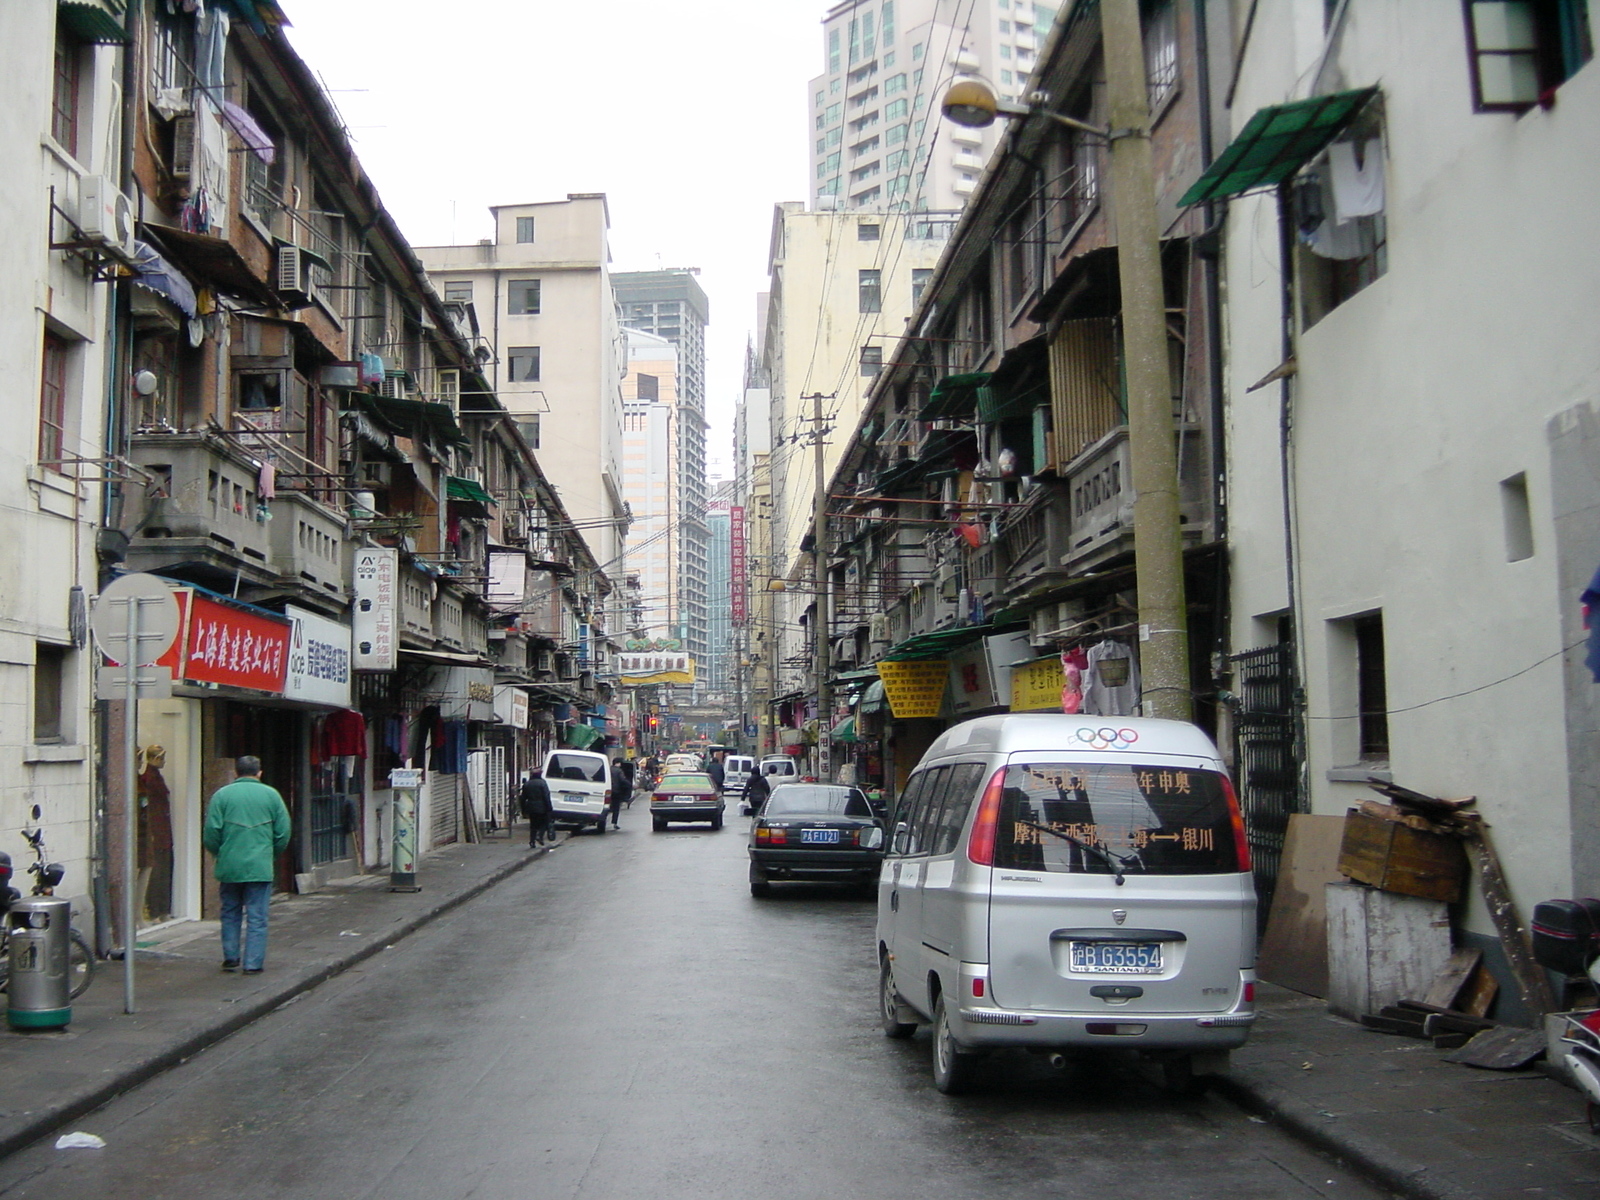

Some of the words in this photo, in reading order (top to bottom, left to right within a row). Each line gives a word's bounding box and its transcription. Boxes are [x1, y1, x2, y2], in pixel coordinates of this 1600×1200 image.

[820, 722, 829, 773] 公用电话
[1182, 826, 1213, 852] 银川
